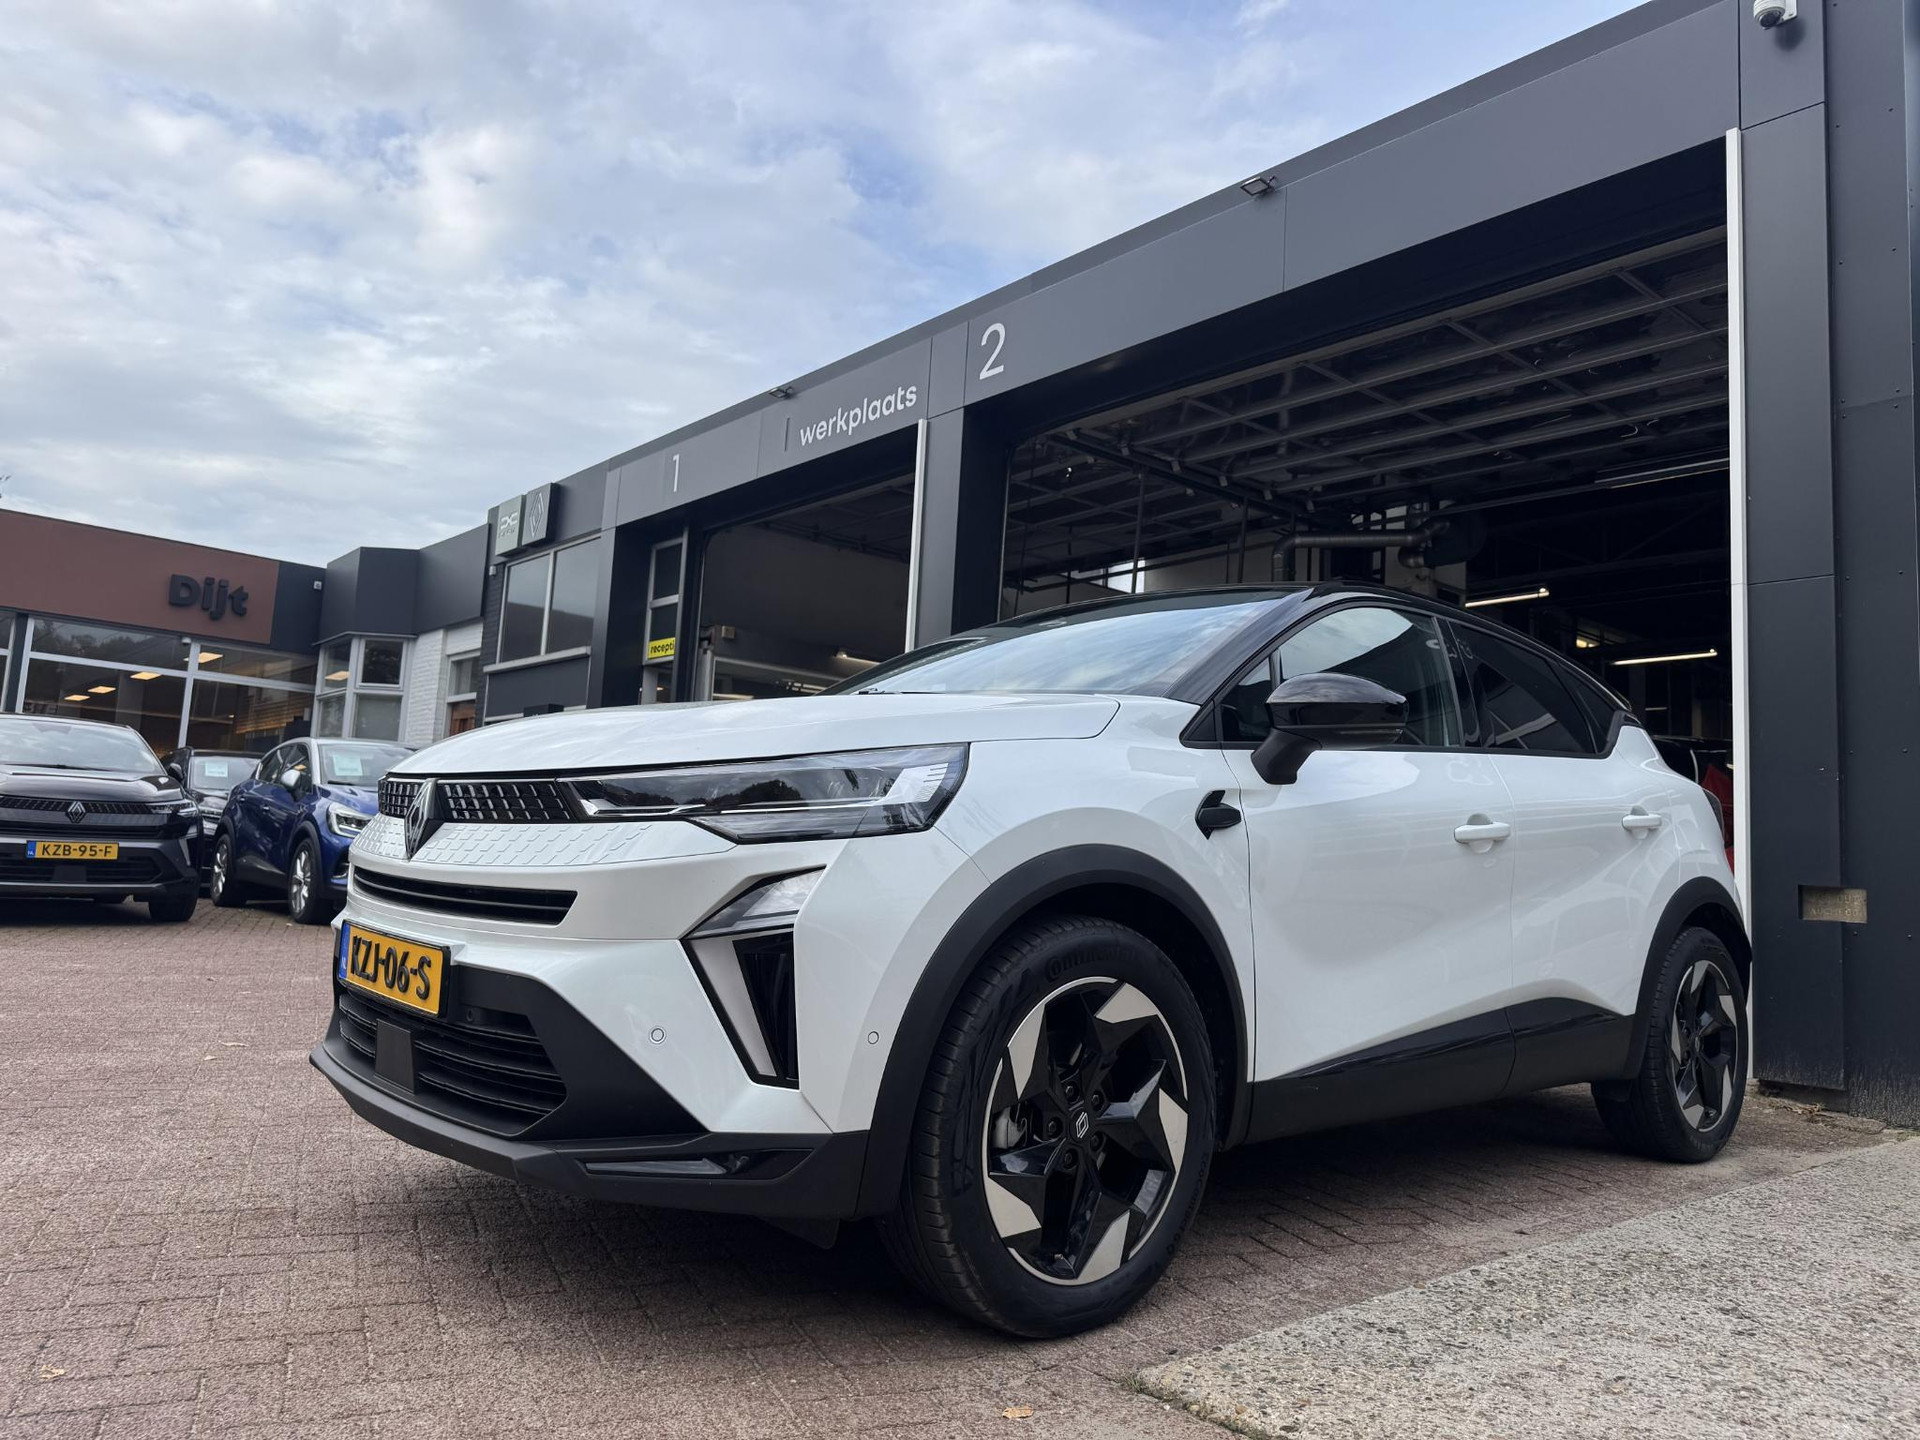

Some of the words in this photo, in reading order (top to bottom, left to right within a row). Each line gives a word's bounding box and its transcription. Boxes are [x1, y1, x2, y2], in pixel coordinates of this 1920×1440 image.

[979, 323, 1006, 380] 2
[799, 385, 918, 446] werkplaats
[672, 453, 680, 493] 1
[168, 574, 249, 620] Dijt
[42, 844, 112, 857] KZB-95-F
[351, 935, 431, 1000] KZJ-06-S
